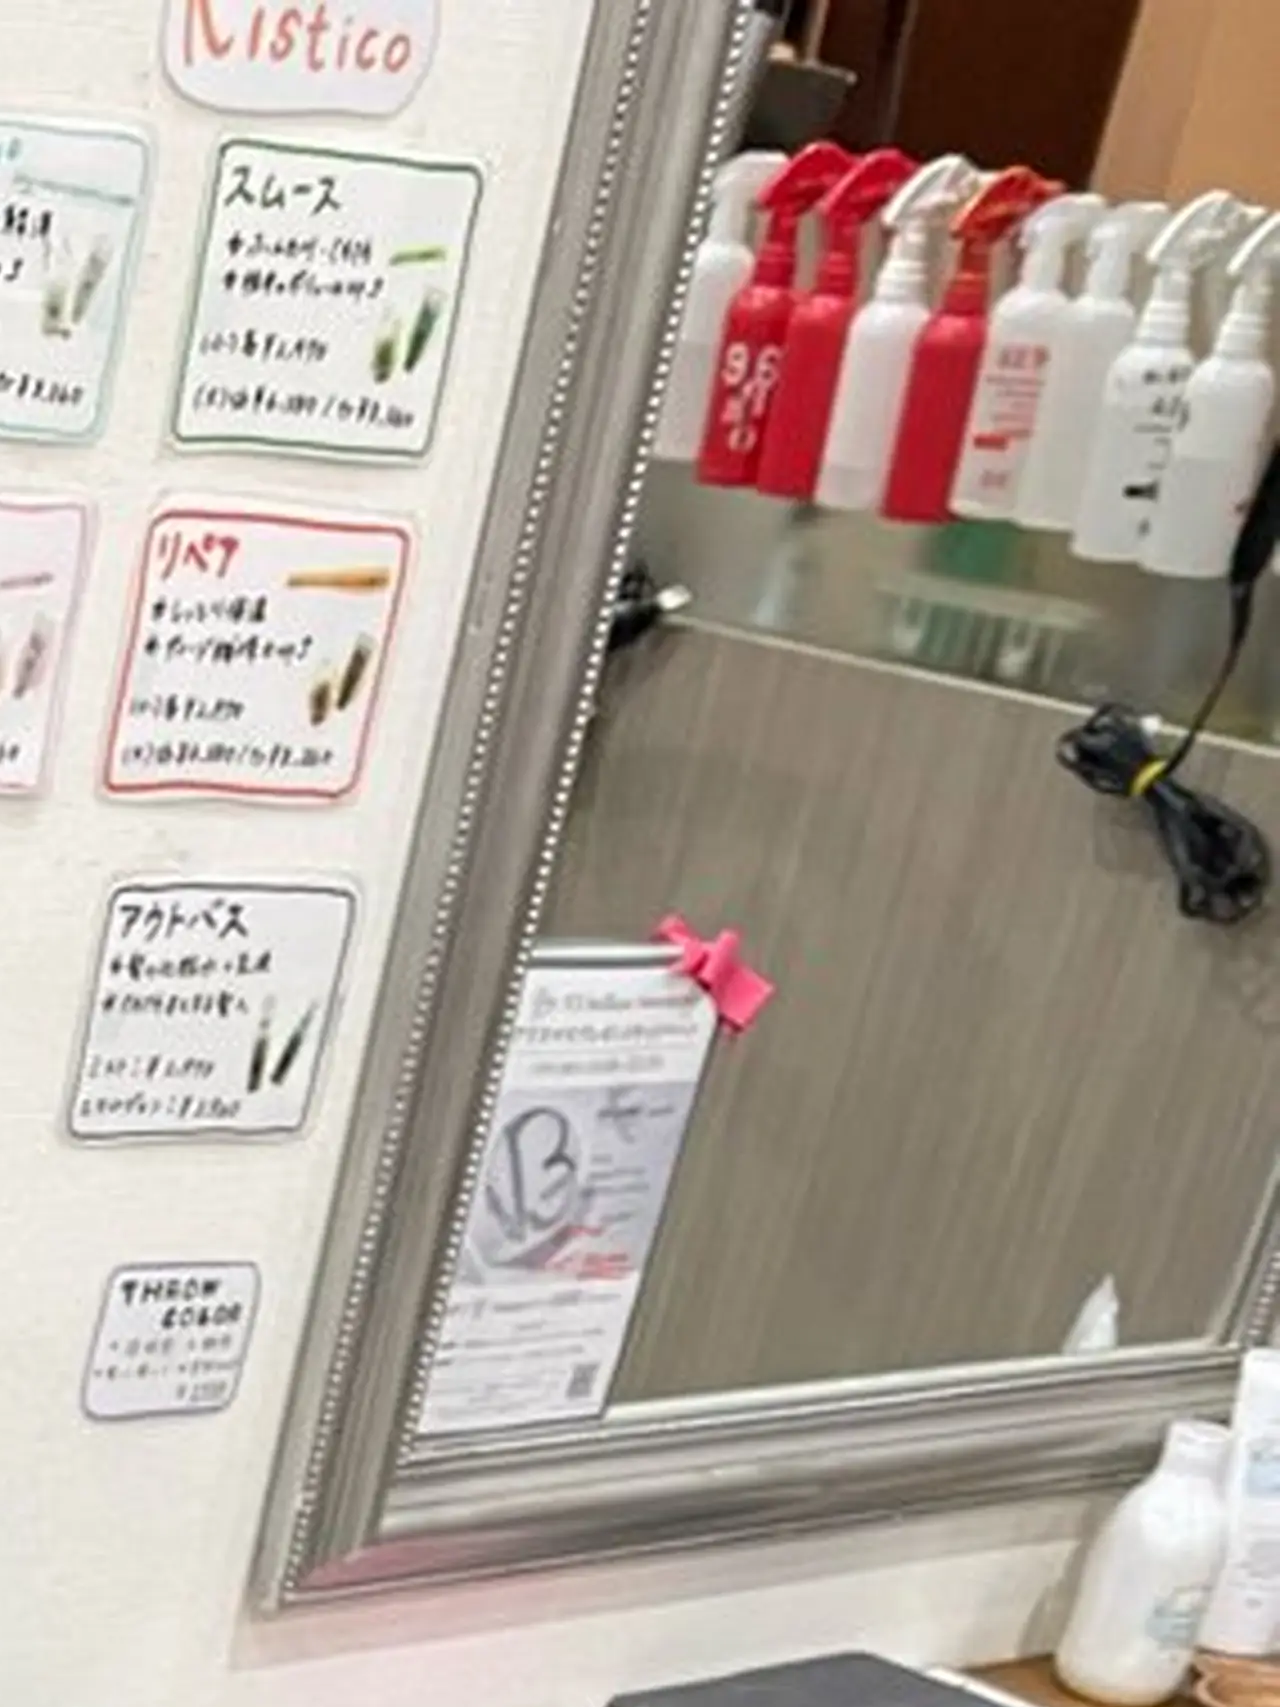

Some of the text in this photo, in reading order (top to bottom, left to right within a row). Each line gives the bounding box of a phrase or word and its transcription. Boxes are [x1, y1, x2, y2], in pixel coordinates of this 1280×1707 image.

[223, 165, 343, 216] スムース
[158, 531, 241, 581] リペア
[118, 899, 250, 943] アウトバス
